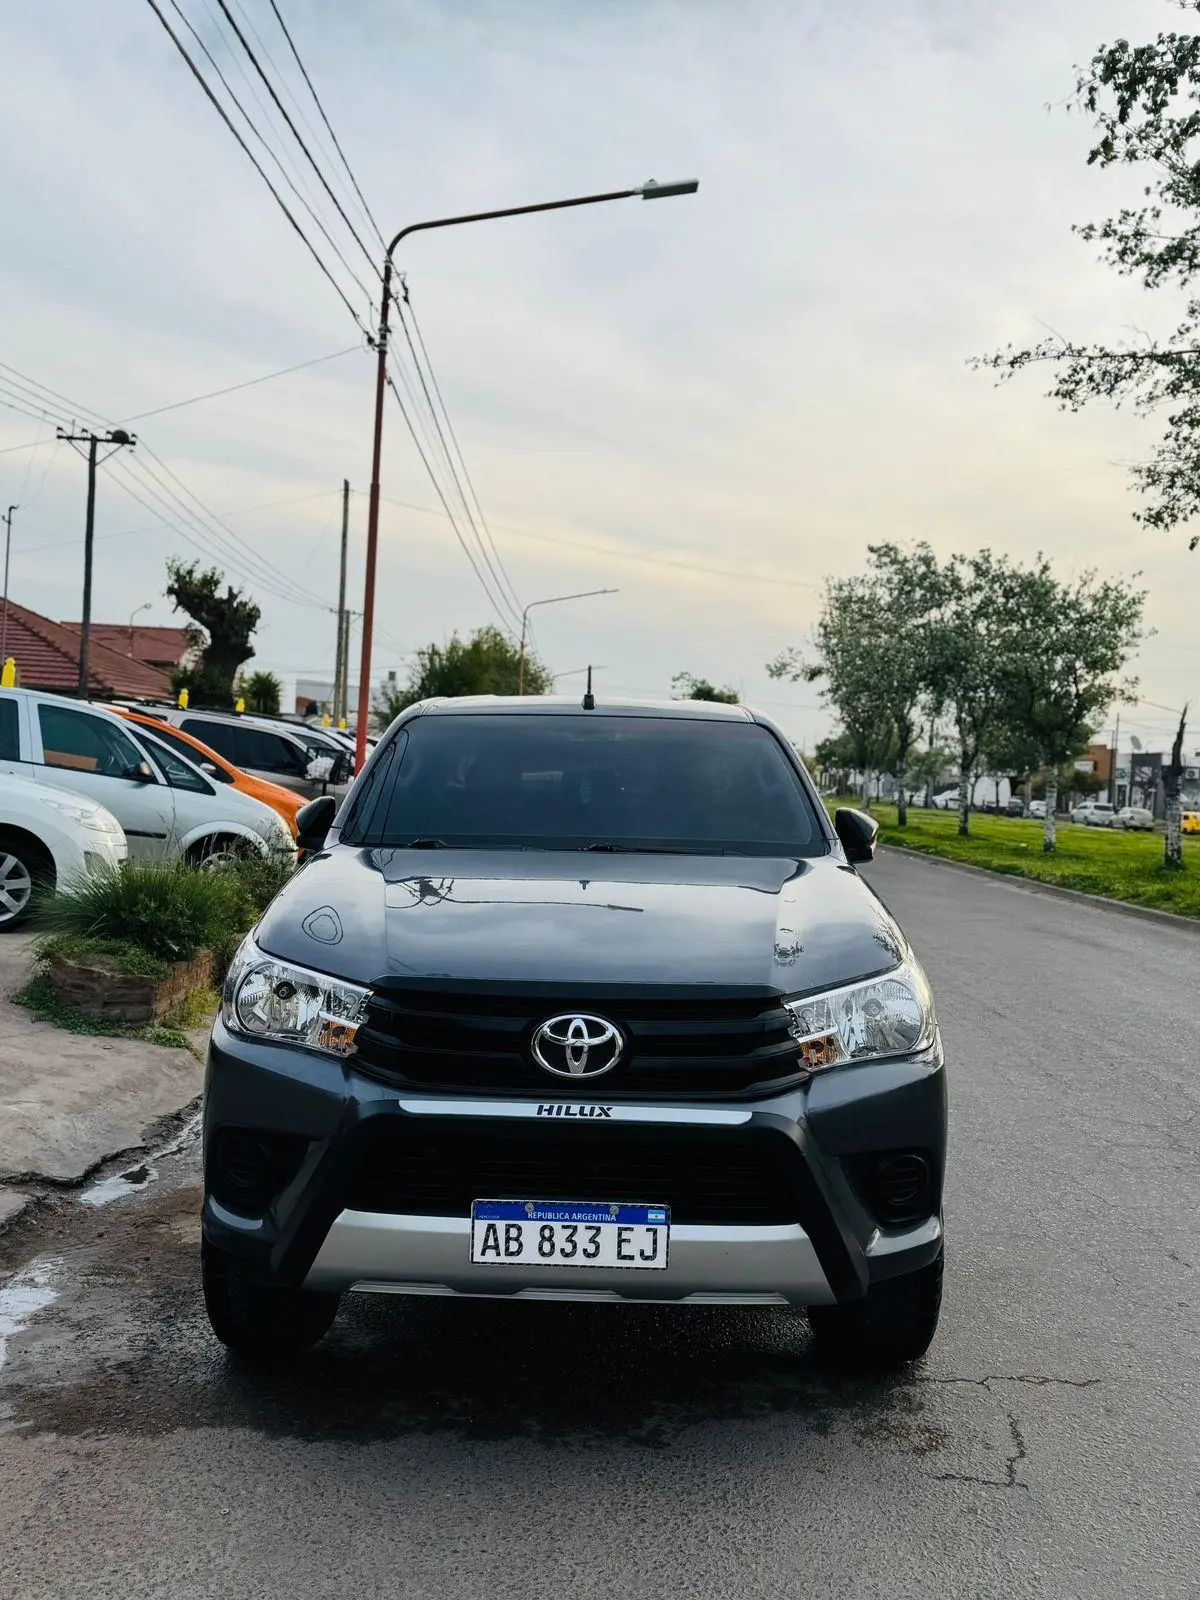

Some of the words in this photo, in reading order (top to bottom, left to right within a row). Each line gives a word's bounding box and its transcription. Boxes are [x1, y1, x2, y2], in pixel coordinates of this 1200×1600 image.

[536, 1104, 613, 1118] HILUX
[527, 1211, 570, 1220] REPUBLICA
[571, 1212, 617, 1222] ARGENTINA
[480, 1223, 524, 1257] AB
[537, 1224, 602, 1259] 833
[616, 1226, 659, 1262] EJ
